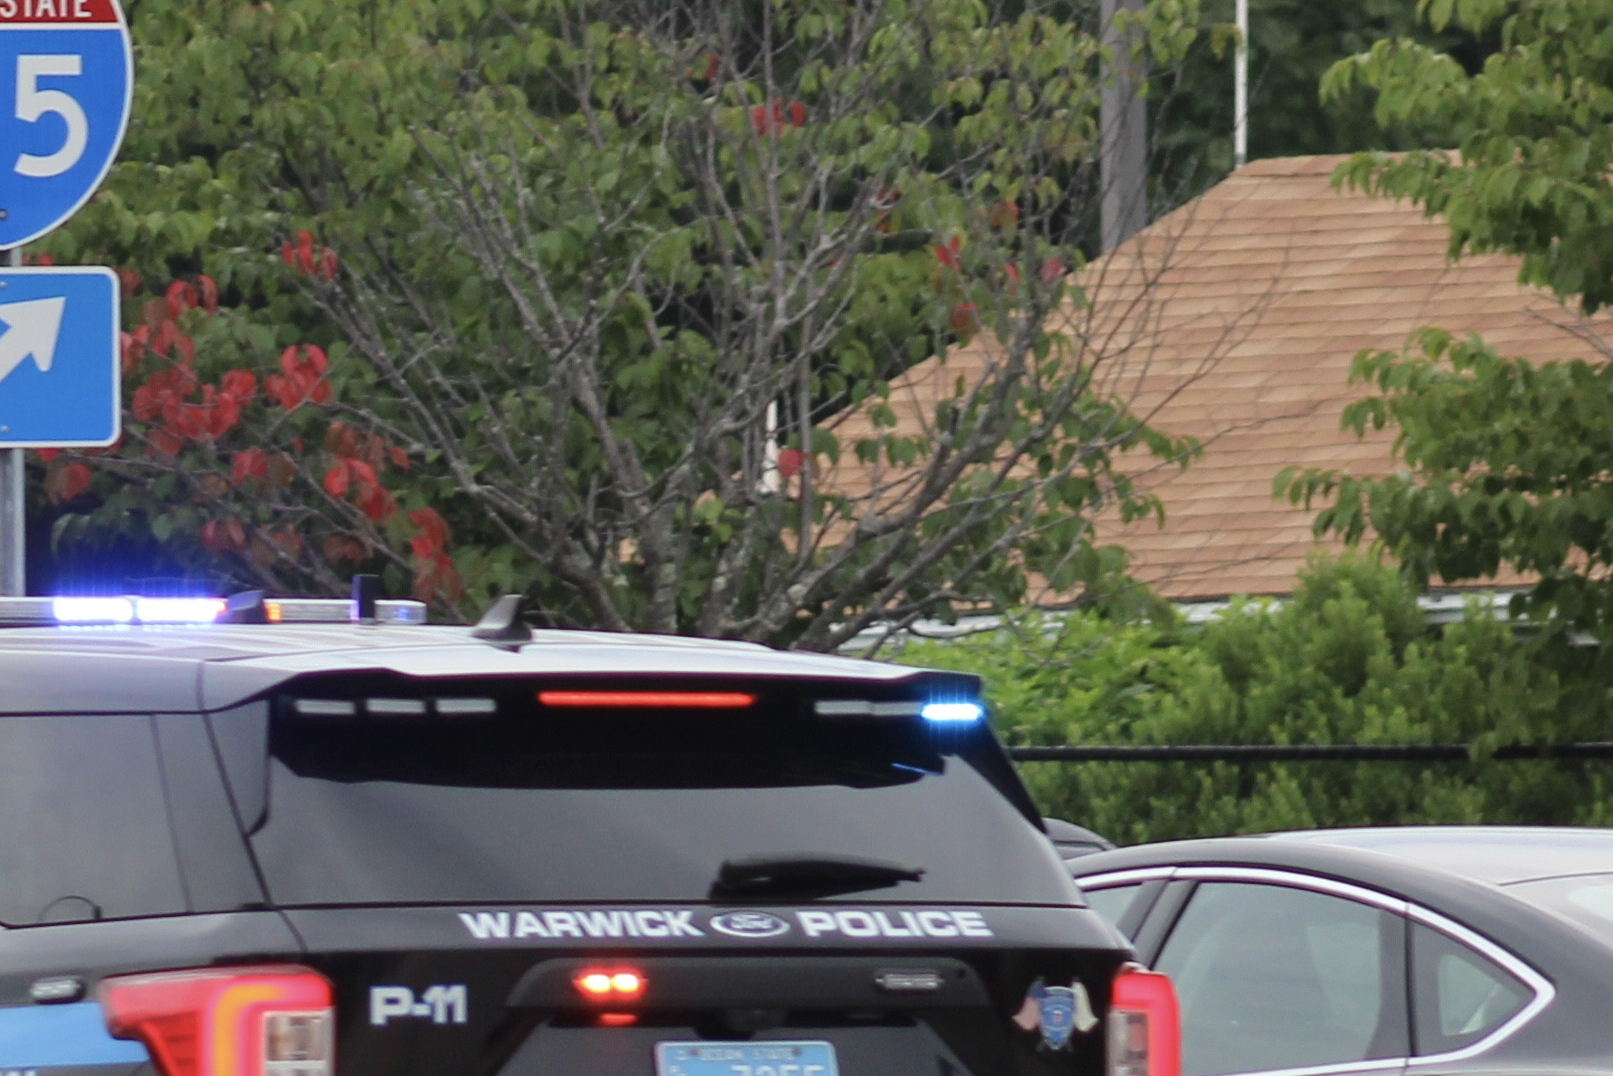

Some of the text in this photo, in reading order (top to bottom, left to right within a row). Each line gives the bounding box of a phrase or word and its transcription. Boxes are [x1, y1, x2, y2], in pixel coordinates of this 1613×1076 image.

[458, 910, 705, 939] WARWICK
[795, 911, 994, 937] POLICE
[370, 985, 467, 1025] P-11
